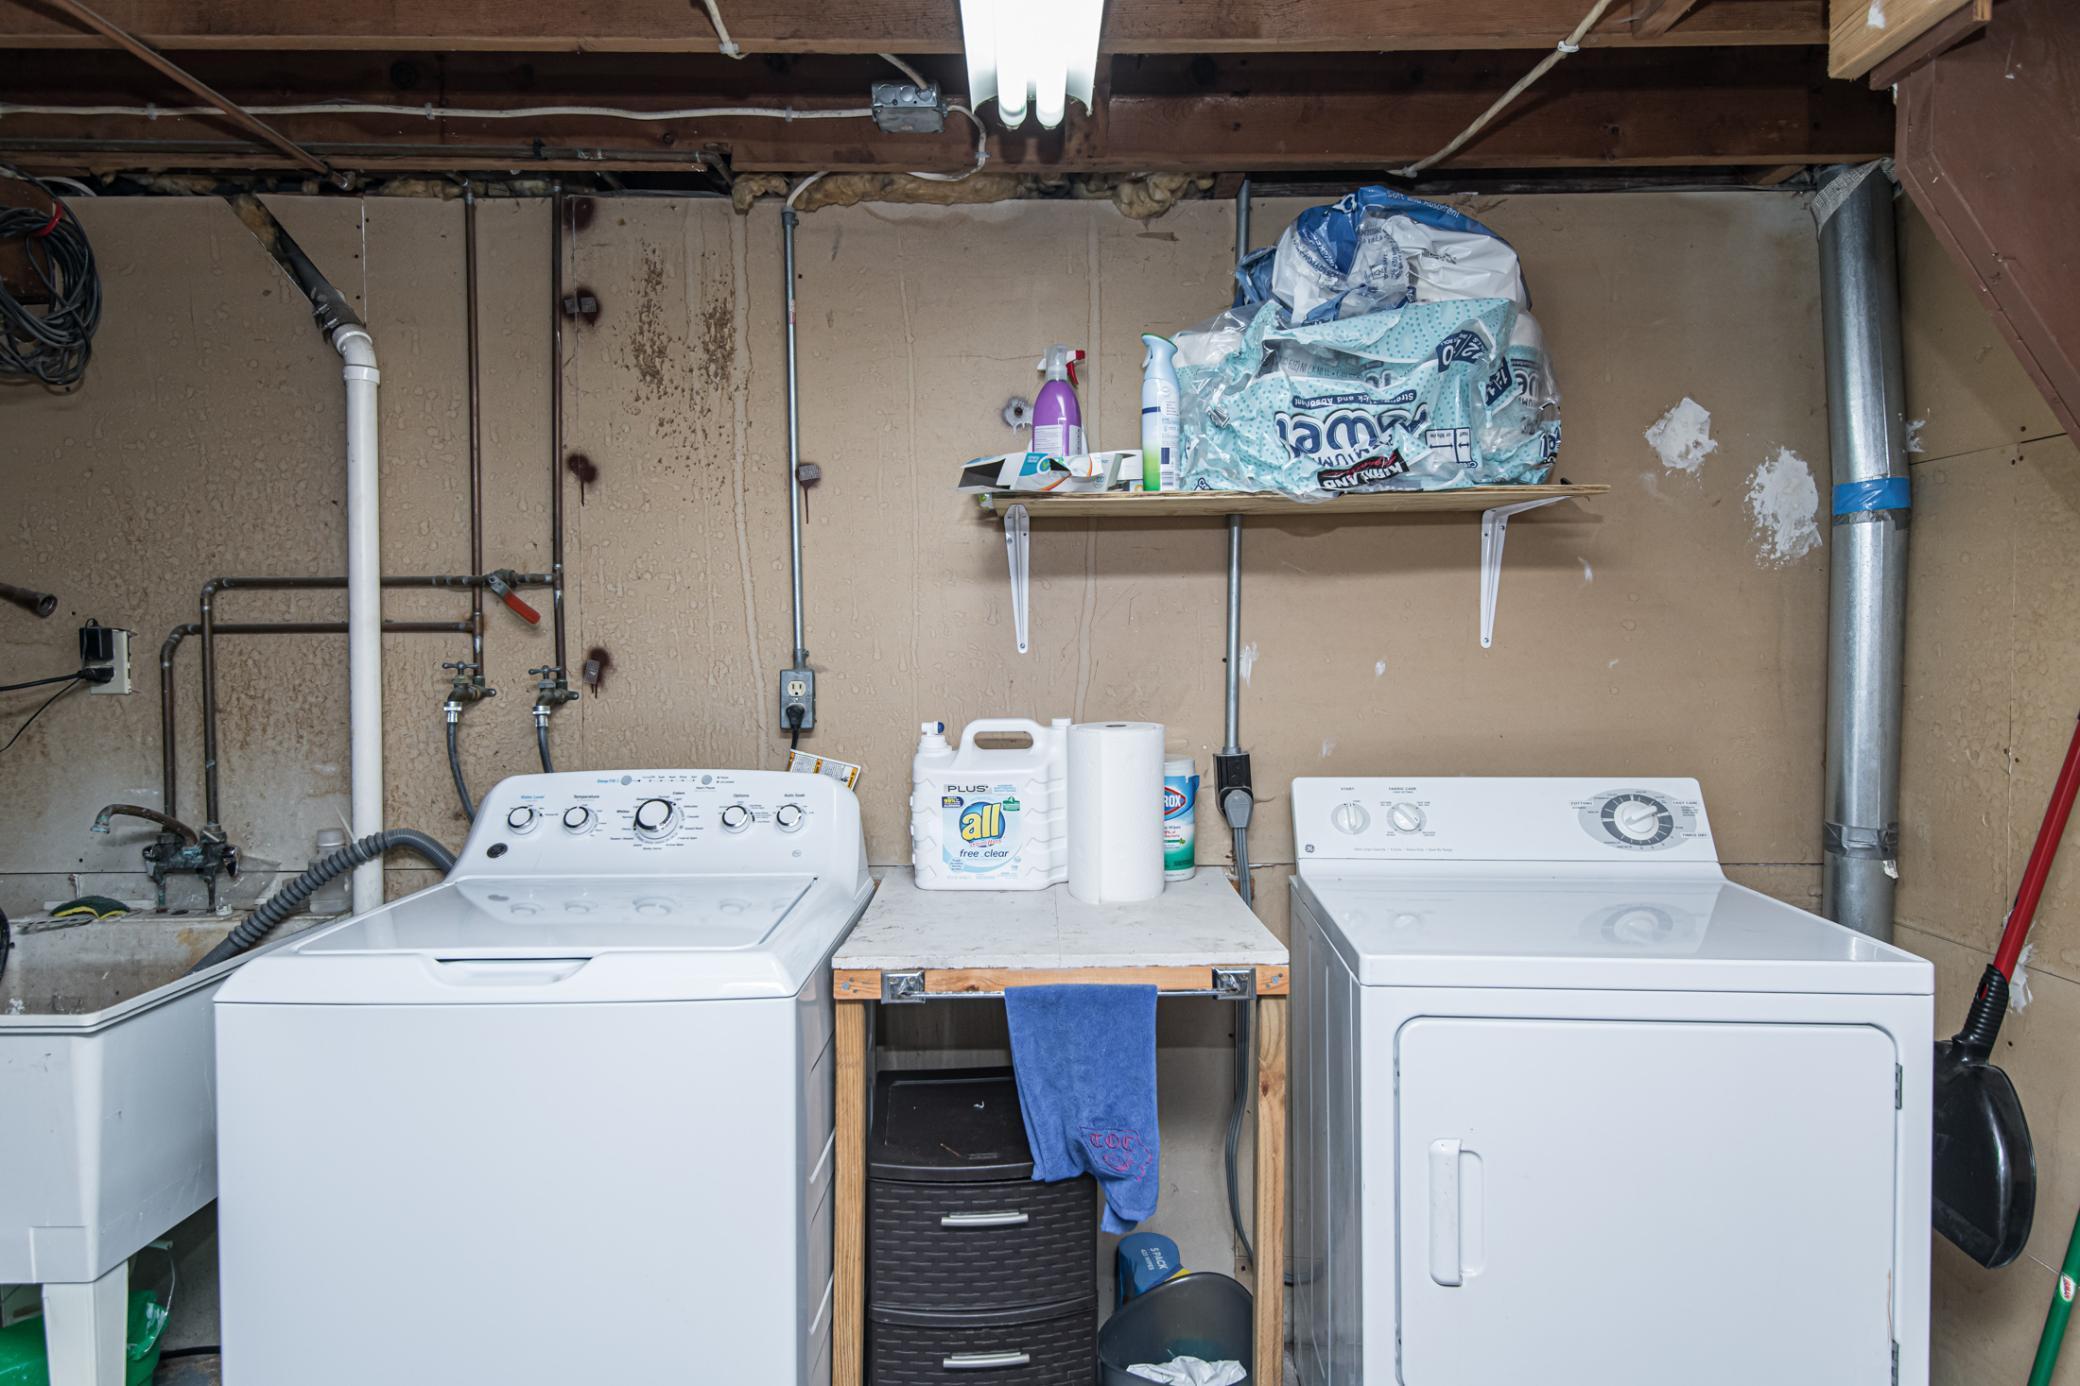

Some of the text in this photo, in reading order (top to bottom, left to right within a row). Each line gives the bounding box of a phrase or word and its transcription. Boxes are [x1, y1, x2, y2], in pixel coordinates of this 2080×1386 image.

[961, 802, 1002, 842] all
[959, 848, 1009, 858] free clear
